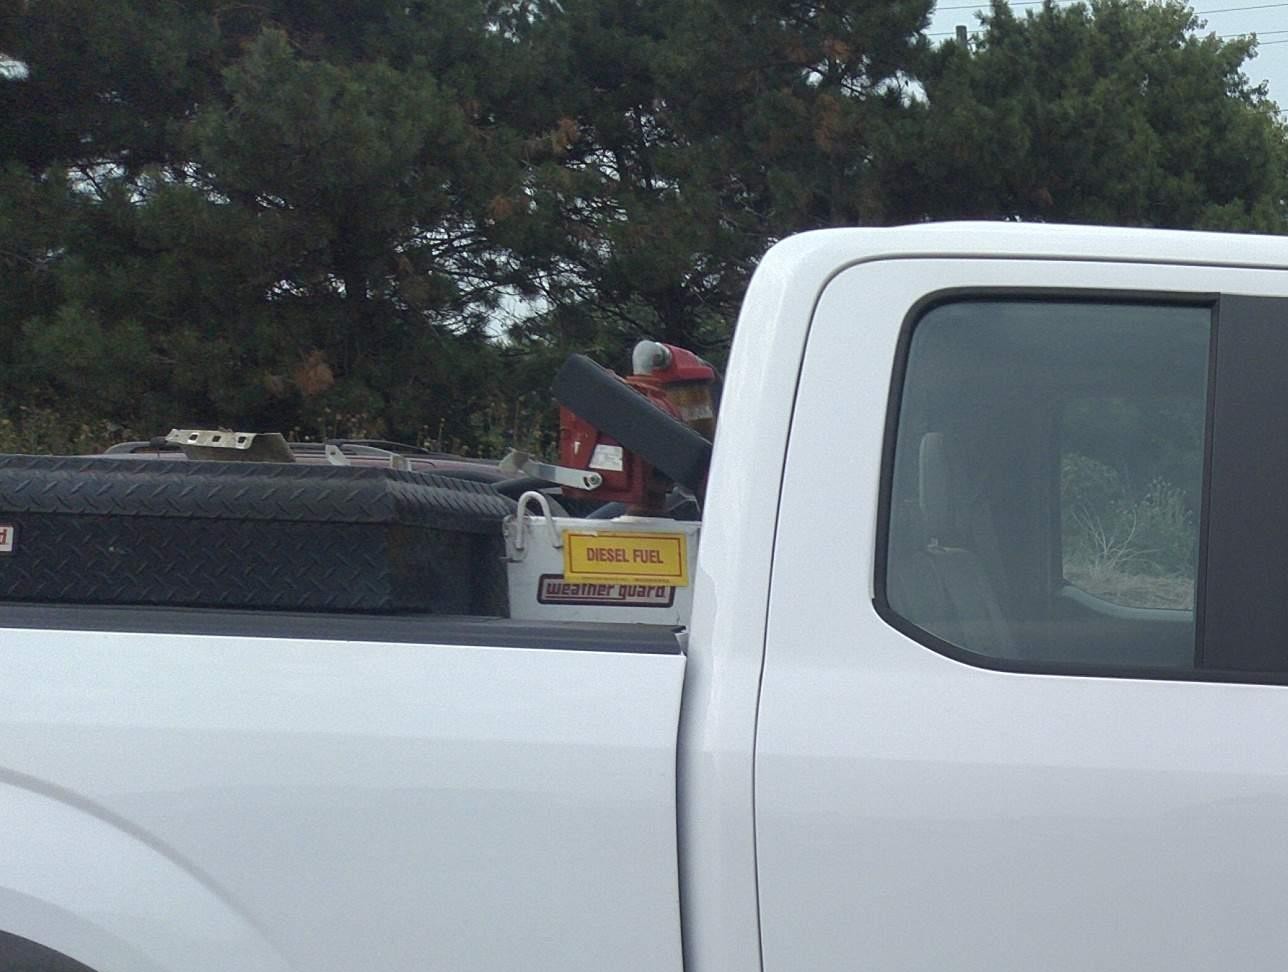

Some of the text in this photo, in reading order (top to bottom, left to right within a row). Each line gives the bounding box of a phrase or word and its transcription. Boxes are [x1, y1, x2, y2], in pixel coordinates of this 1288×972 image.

[587, 547, 664, 564] DIESEL FUEL
[546, 583, 666, 600] weather guard
